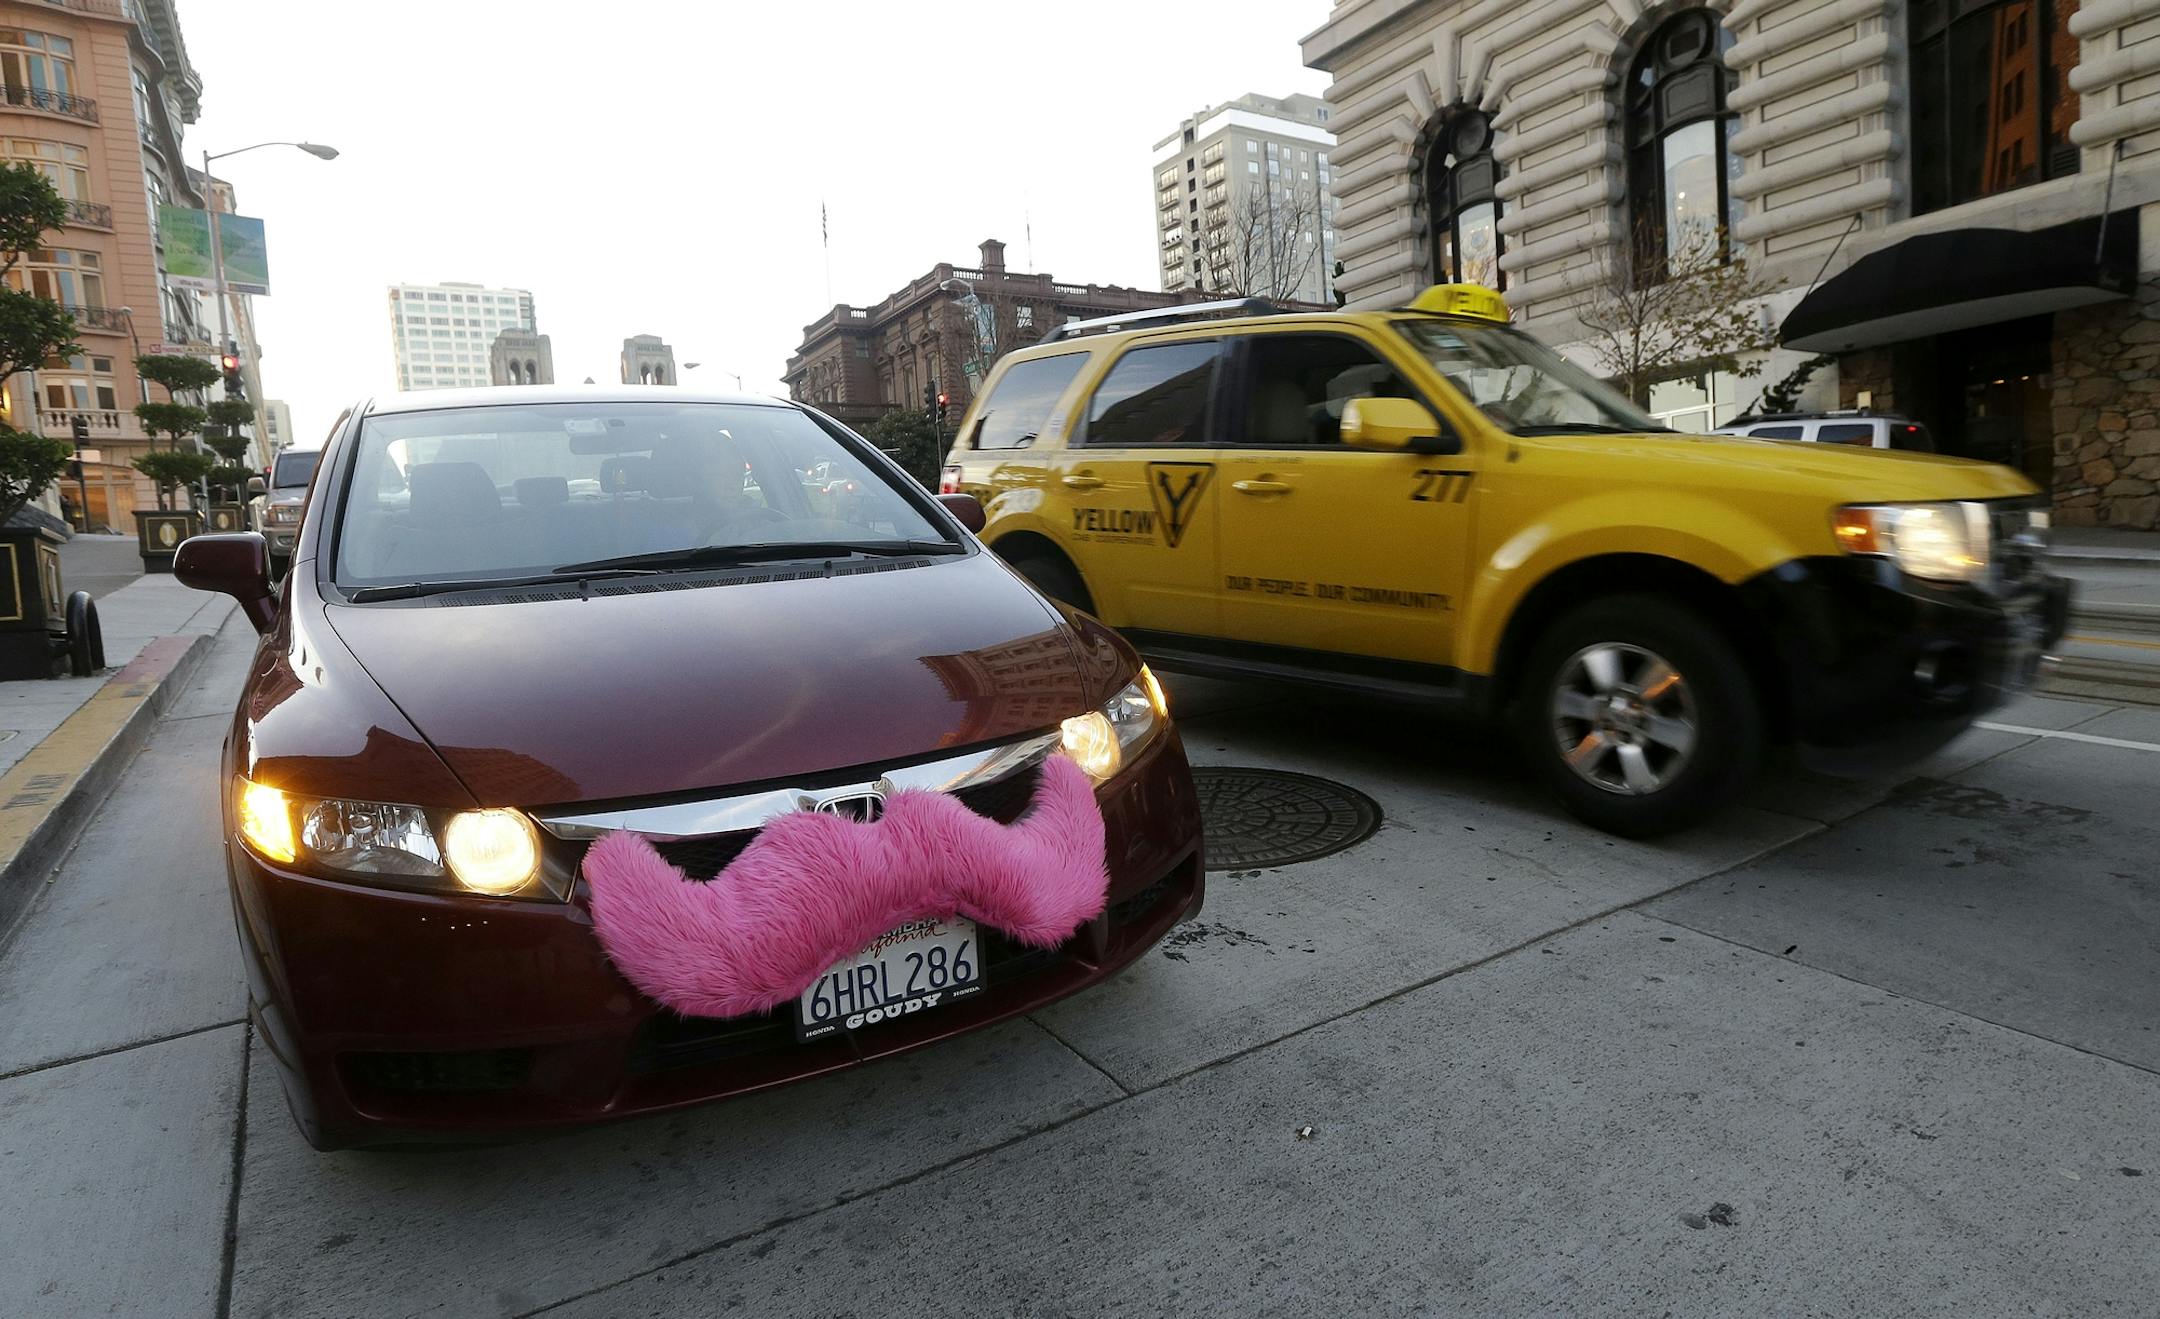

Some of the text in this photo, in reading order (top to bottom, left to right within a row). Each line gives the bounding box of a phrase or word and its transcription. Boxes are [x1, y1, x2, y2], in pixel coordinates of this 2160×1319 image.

[1410, 469, 1476, 503] 277
[1072, 508, 1156, 534] YELLOW
[1226, 575, 1252, 591] OUR
[1315, 583, 1346, 600] OUR
[811, 939, 971, 1022] 6HRL286
[806, 986, 980, 1038] HONDA GOUDY HONDA
